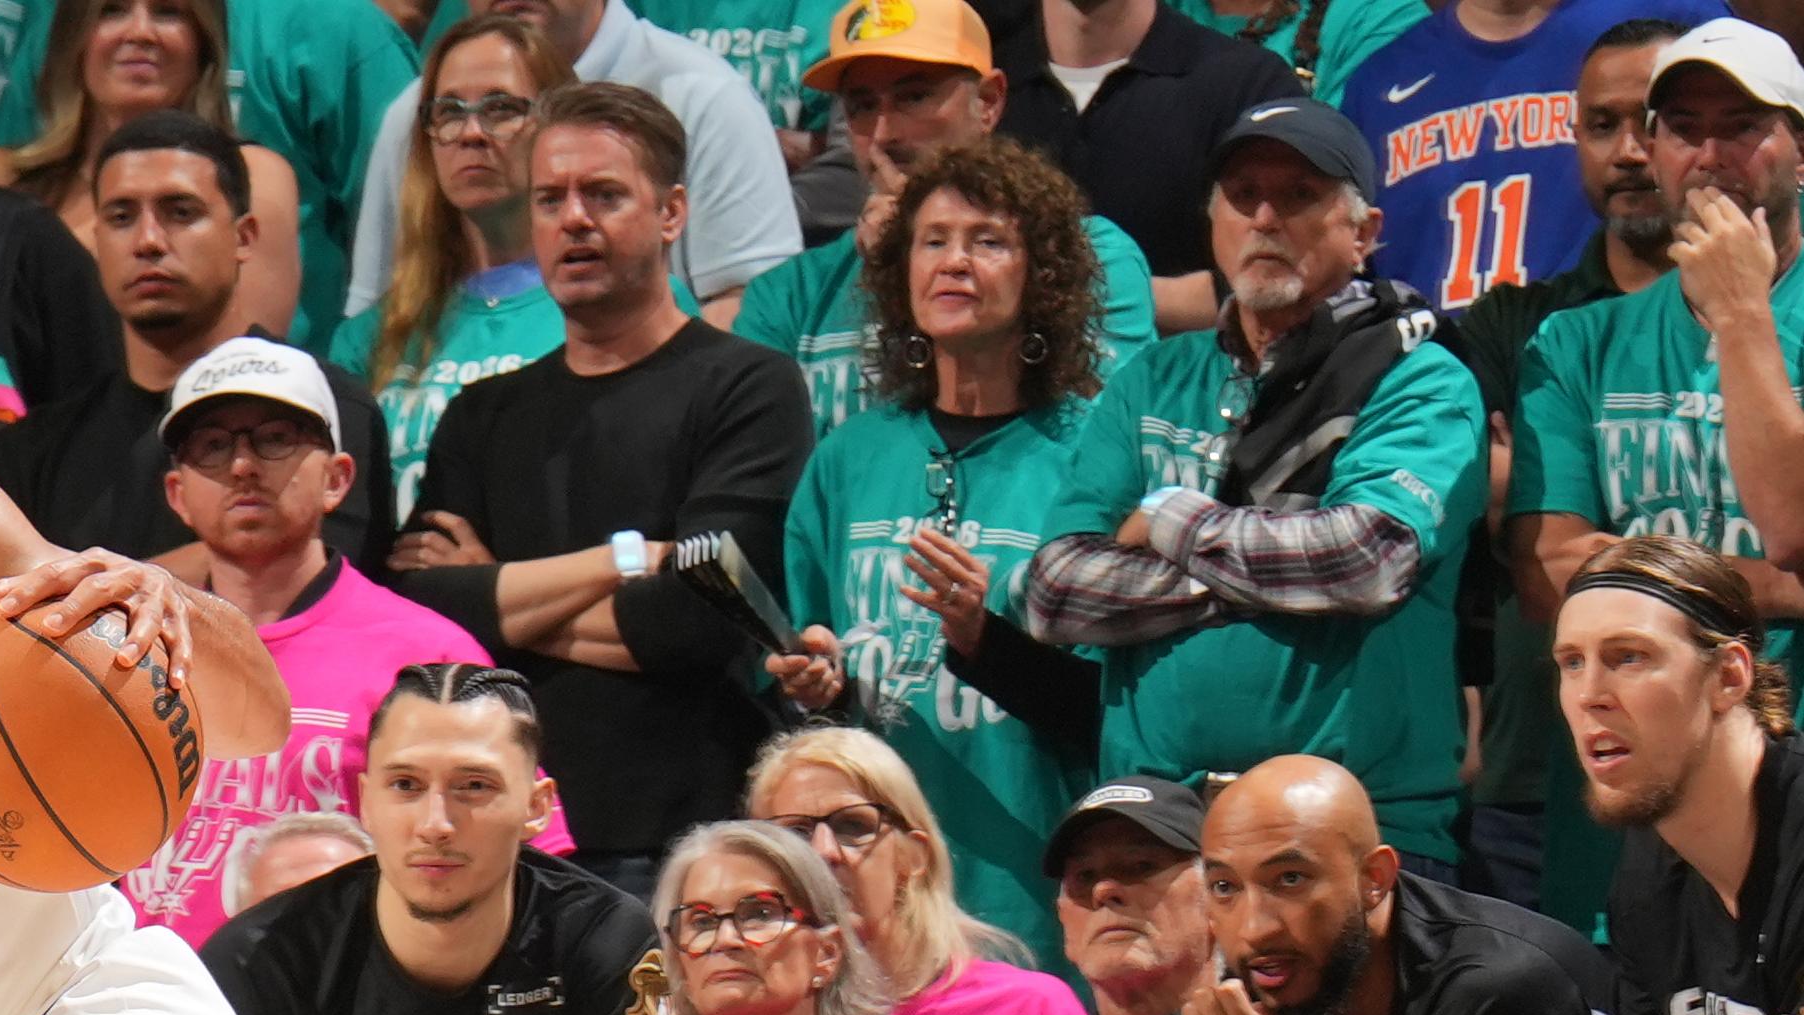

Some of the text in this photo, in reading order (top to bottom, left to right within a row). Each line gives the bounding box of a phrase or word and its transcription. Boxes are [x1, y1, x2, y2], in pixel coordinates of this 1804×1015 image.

[1385, 91, 1578, 187] NEW YOR
[1441, 173, 1532, 310] 11
[1674, 391, 1724, 423] 202
[1594, 417, 1738, 525] FIN
[891, 516, 982, 548] 26
[199, 735, 349, 819] ALS
[498, 987, 554, 1006] LEDGER
